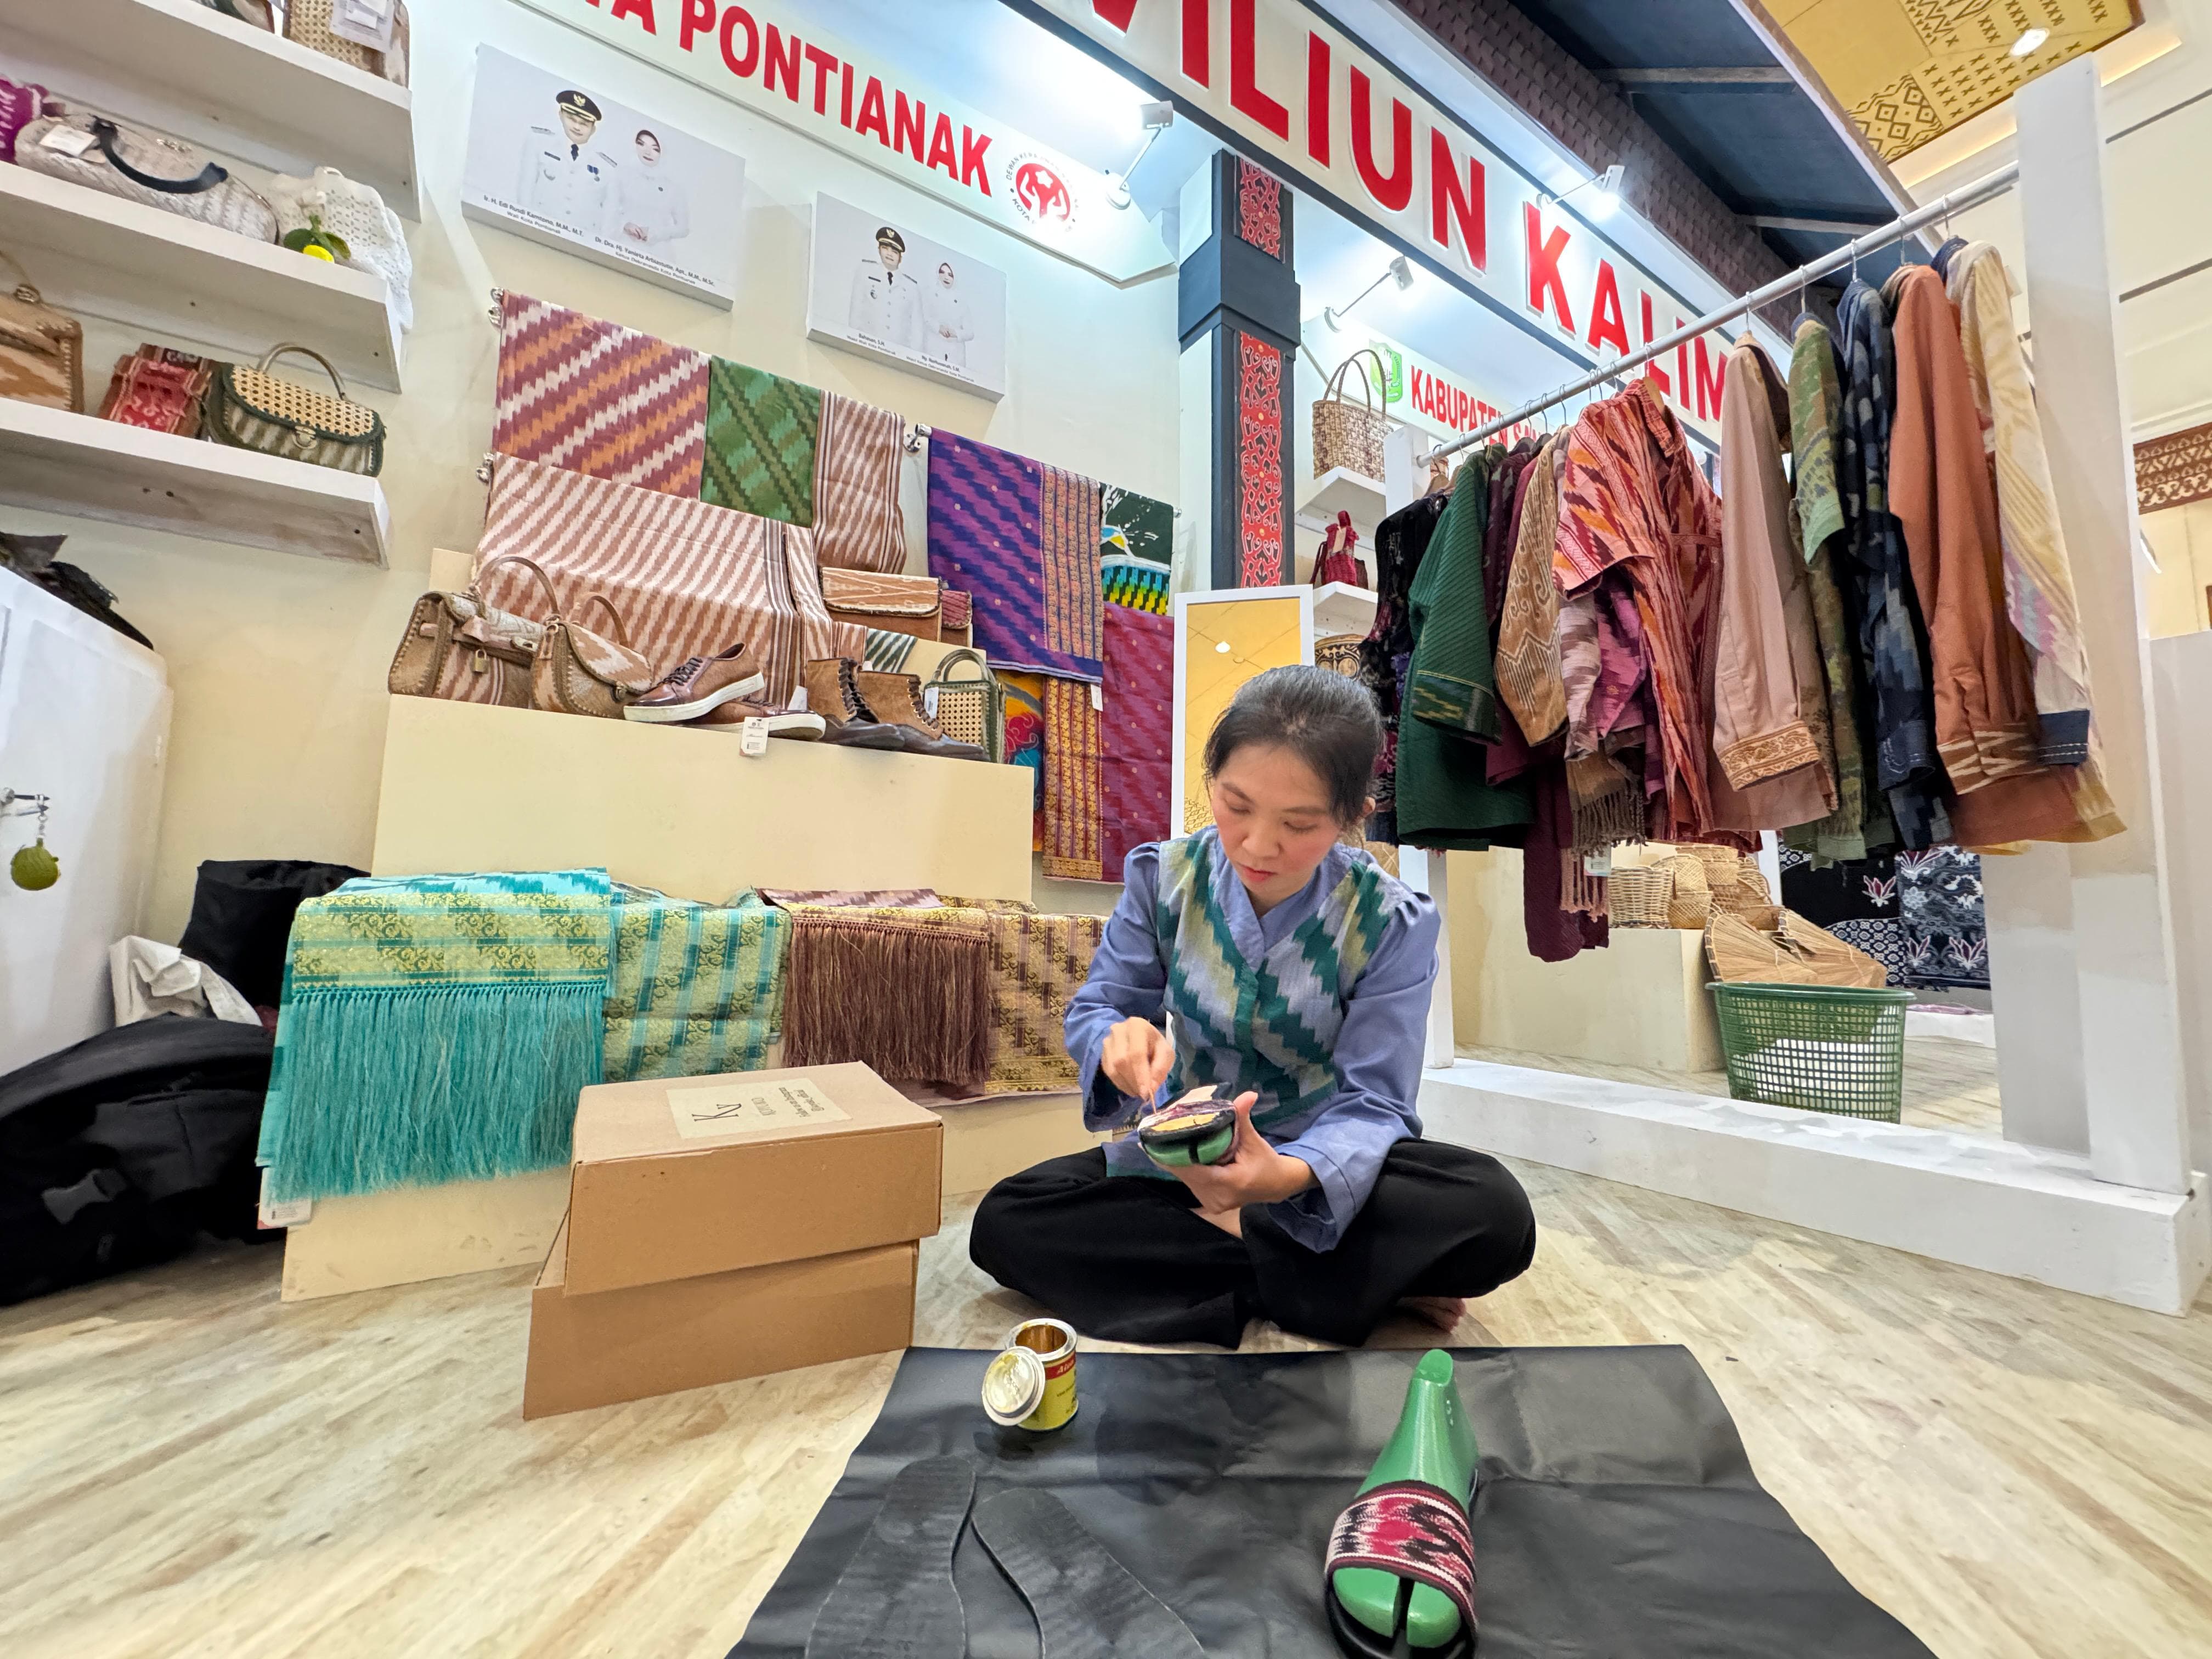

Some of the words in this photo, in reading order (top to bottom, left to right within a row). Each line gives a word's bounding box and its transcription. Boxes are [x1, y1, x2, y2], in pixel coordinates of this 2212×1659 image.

[680, 0, 992, 198] PONTIANAK
[1093, 0, 1487, 274] ILIUN
[1006, 157, 1019, 180] DEWAN
[510, 205, 526, 215] Rusdi
[1012, 199, 1030, 221] KOTA
